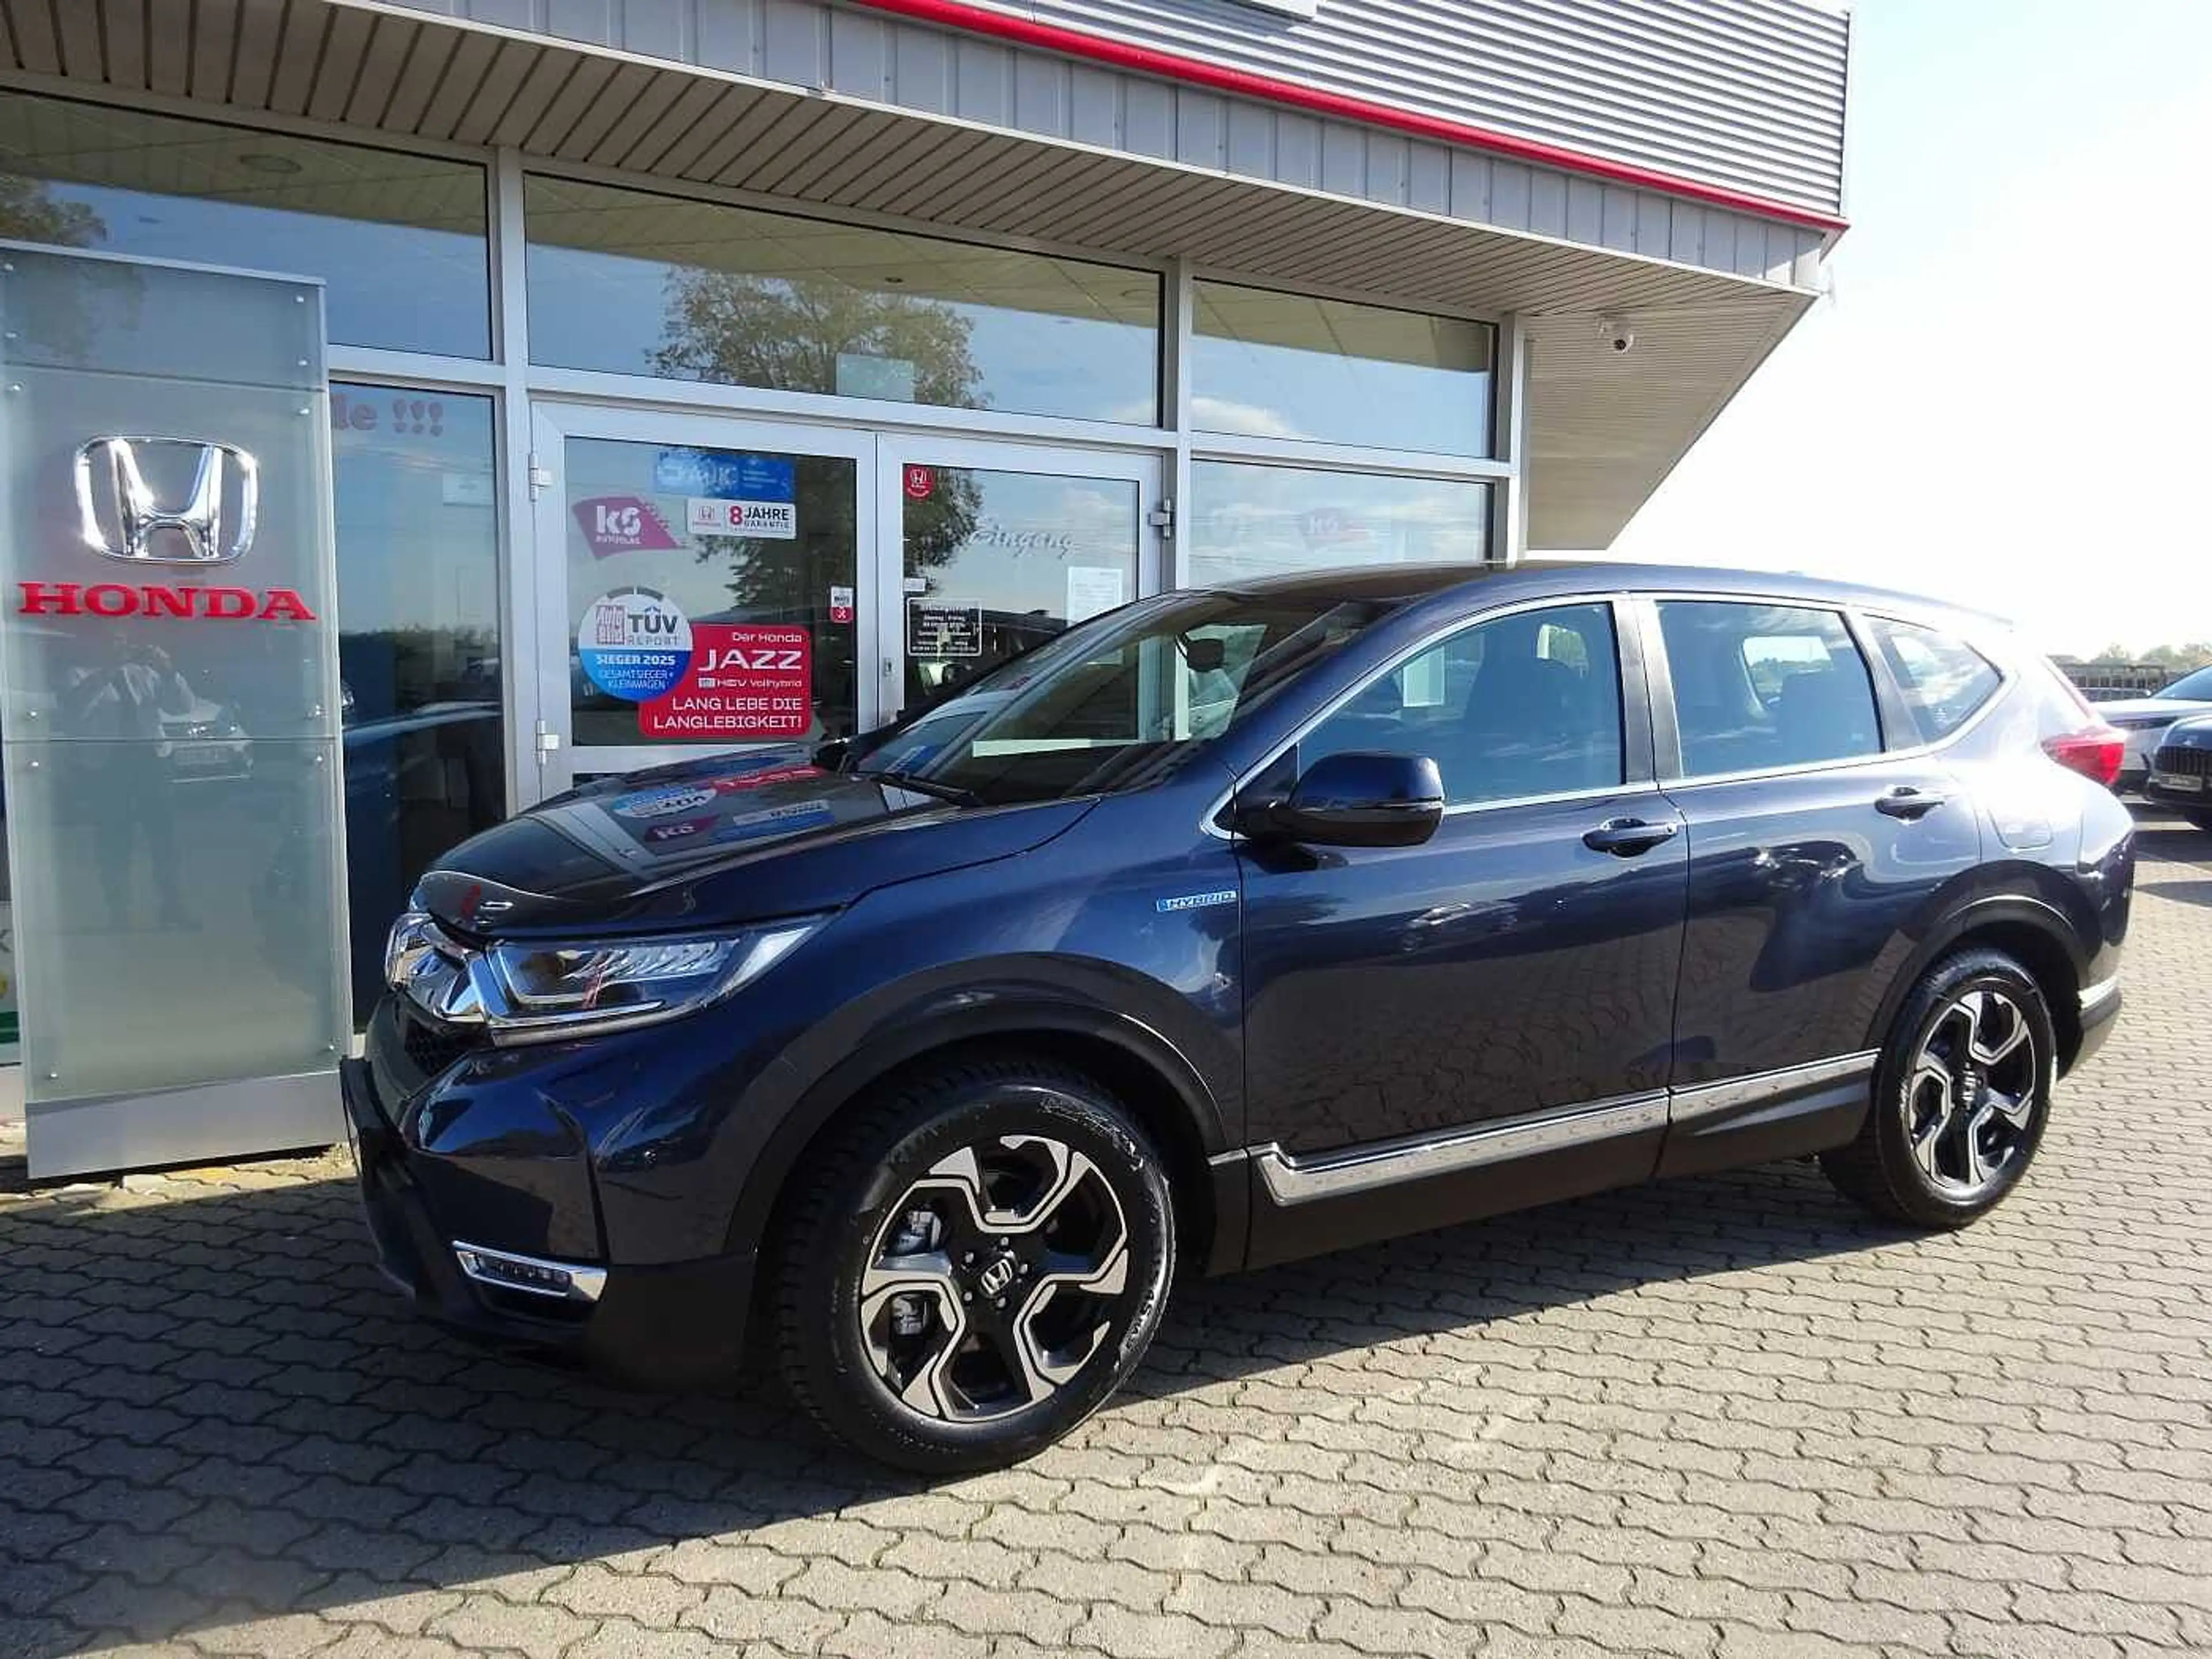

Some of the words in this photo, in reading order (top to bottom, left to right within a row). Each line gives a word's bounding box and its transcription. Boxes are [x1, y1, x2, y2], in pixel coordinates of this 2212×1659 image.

[730, 506, 743, 525] 8
[744, 506, 790, 521] JAHRE
[18, 582, 316, 621] HONDA
[733, 632, 755, 642] Der
[758, 633, 802, 643] Honda
[643, 655, 676, 665] 2025
[697, 649, 802, 671] JAZZ
[672, 696, 721, 710] LANG
[725, 697, 770, 711] LEBE
[772, 698, 802, 711] DIE
[654, 715, 802, 729] LANGLEBIGKEIT!
